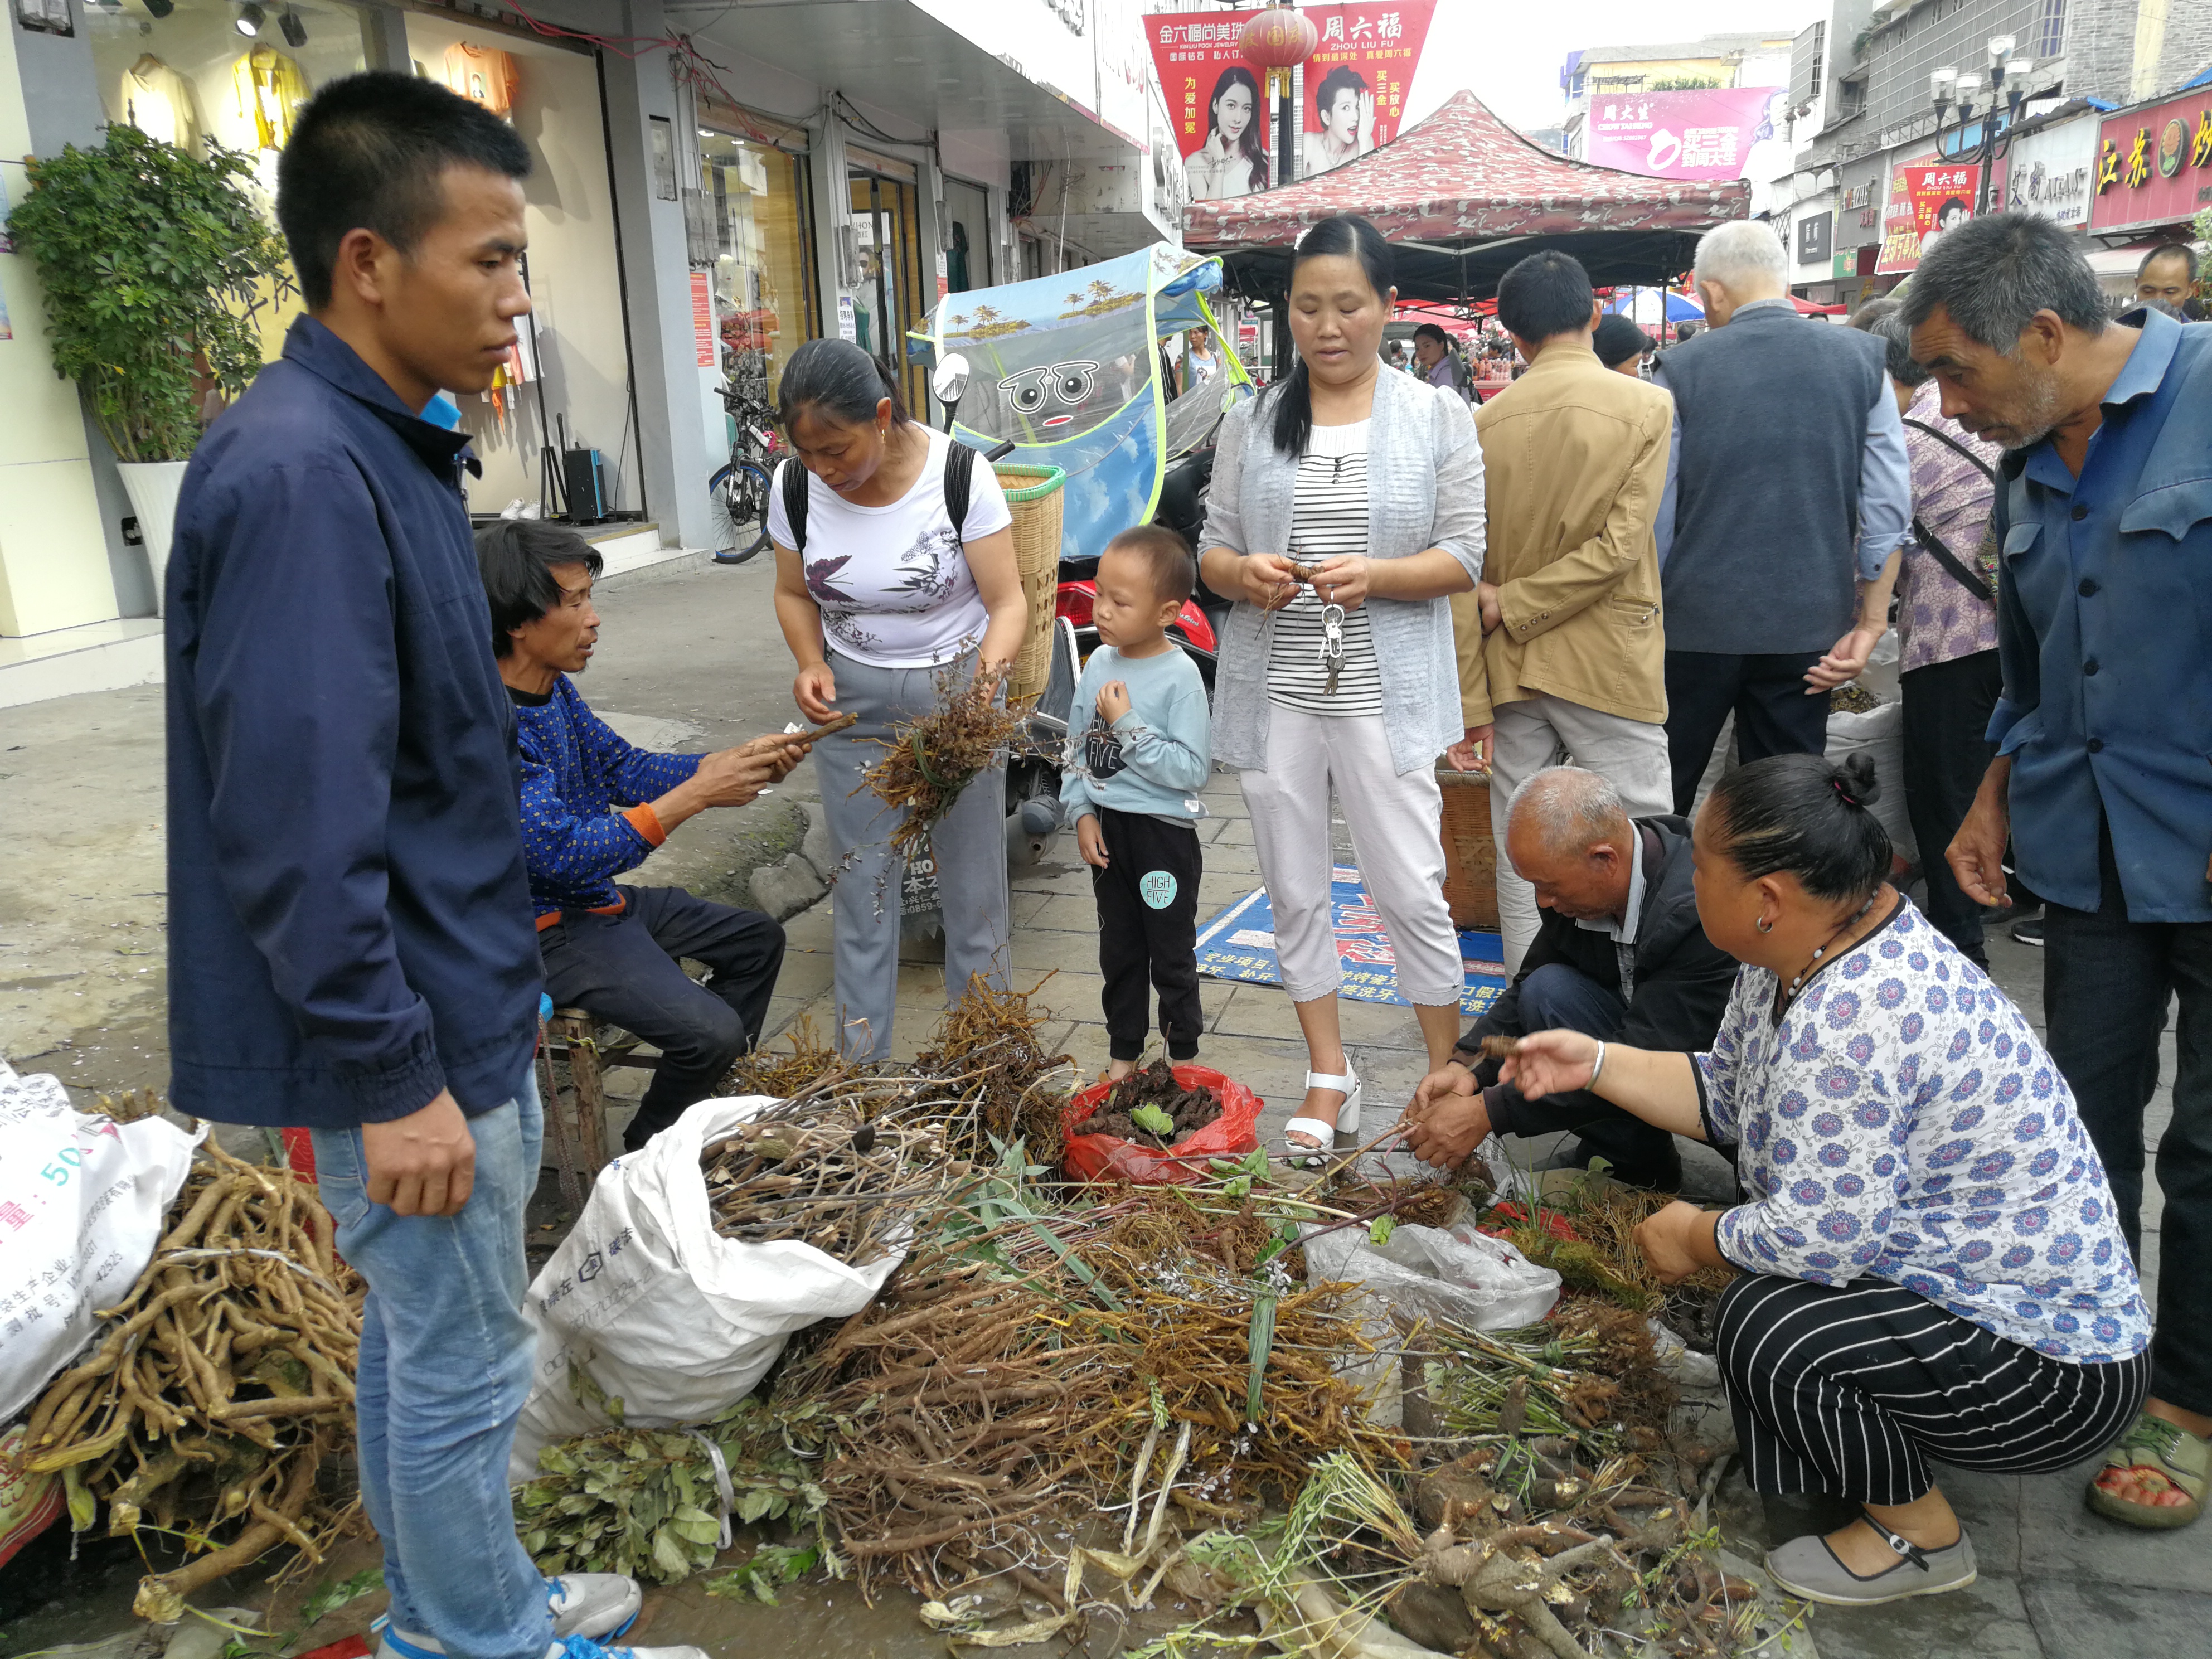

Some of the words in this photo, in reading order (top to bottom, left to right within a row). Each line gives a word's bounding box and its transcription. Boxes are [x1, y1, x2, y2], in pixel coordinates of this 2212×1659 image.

[1322, 12, 1402, 42] 周六福
[1331, 42, 1357, 51] ZHOU
[1361, 41, 1376, 50] LIU
[1381, 40, 1394, 48] FU
[1170, 51, 1205, 62] 国际钻石
[1213, 50, 1243, 60] 私人订
[1312, 51, 1358, 63] 情到最深处
[1366, 48, 1411, 61] 真爱周六福
[1376, 70, 1388, 106] 买三金
[1184, 77, 1196, 134] 为爱加冕
[1389, 81, 1400, 118] 买放心
[1602, 103, 1649, 122] 周大生
[1682, 134, 1739, 153] 买三金
[1681, 152, 1737, 167] 到周大生
[2097, 128, 2147, 196] 江苏
[1922, 171, 1967, 186] 周六福
[1089, 741, 1120, 769] FIVE
[1146, 875, 1170, 890] HIGH
[1146, 890, 1170, 904] FIVE
